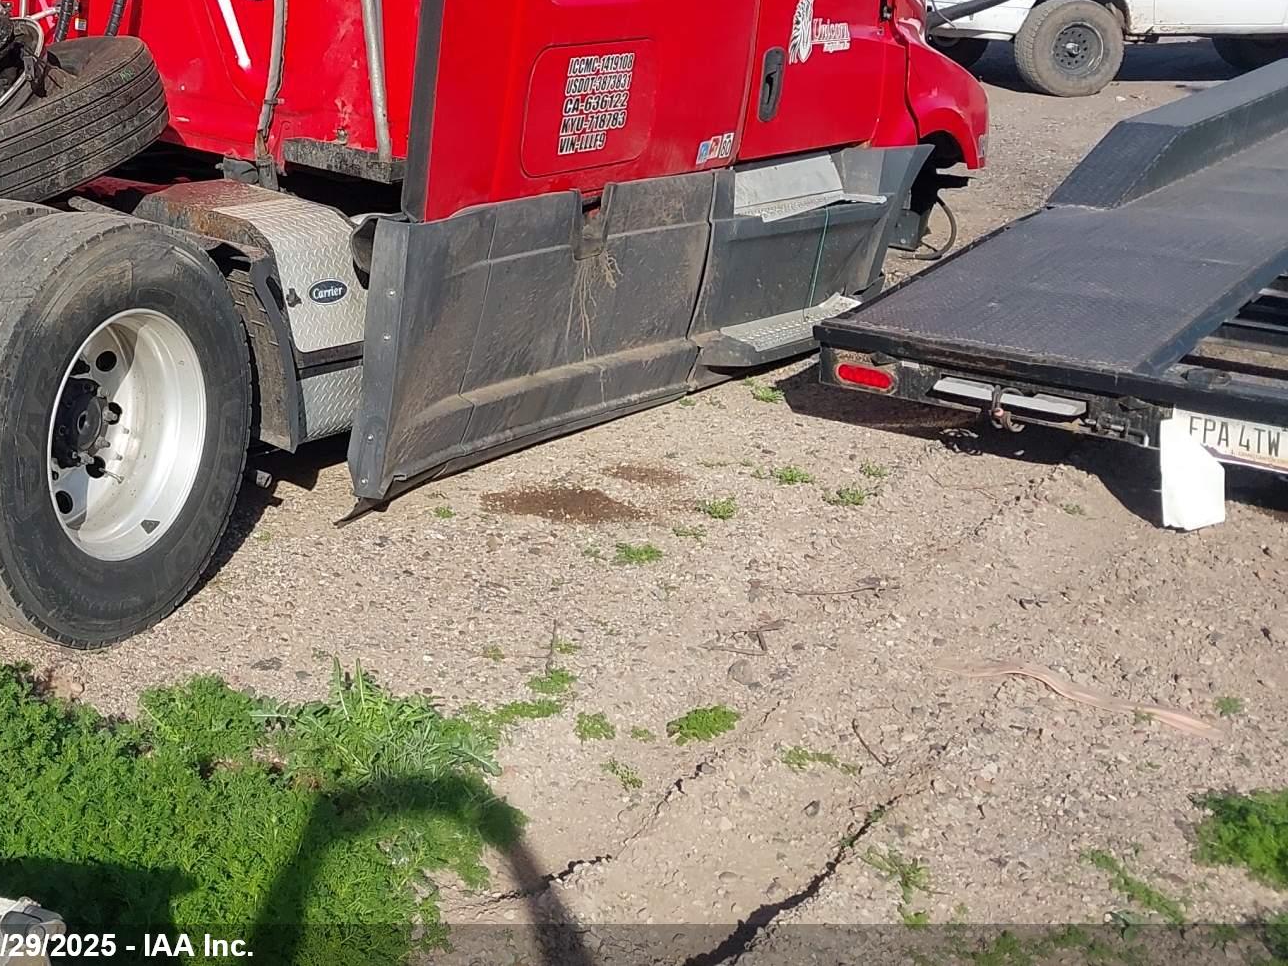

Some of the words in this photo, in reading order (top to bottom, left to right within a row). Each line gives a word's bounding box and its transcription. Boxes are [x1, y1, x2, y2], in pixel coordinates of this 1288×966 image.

[563, 92, 629, 115] CA-636122
[560, 111, 627, 135] KYU-718783
[313, 286, 342, 299] Carrier
